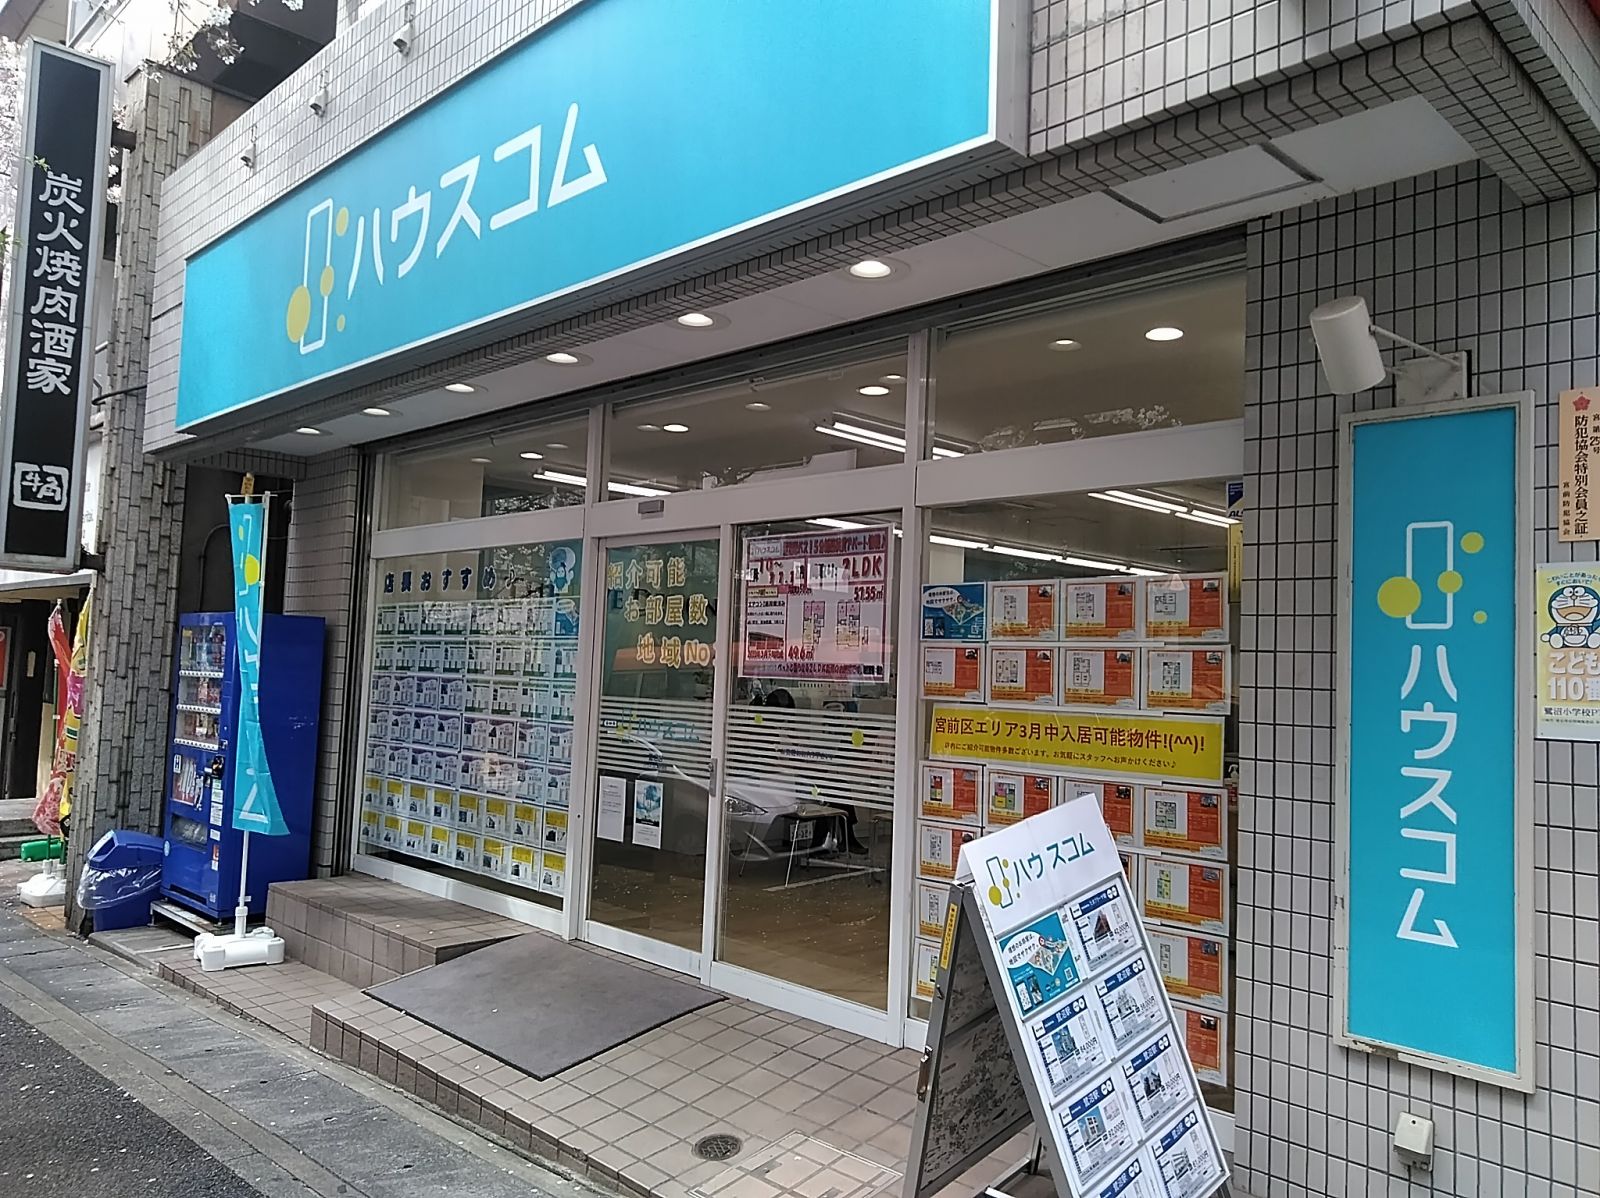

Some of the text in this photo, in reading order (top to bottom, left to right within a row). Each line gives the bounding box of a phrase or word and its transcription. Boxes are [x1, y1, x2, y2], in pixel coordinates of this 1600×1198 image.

[347, 101, 608, 301] ハウスコム
[25, 170, 85, 396] 炭火焼肉酒家
[20, 469, 63, 503] 牛角
[1574, 415, 1589, 535] 防犯協会特別会員之証
[624, 594, 709, 627] お部屋数
[1548, 651, 1600, 676] こども
[1548, 676, 1600, 702] 110番
[1396, 644, 1459, 948] ハウスコム
[1014, 833, 1095, 888] ハウスコム
